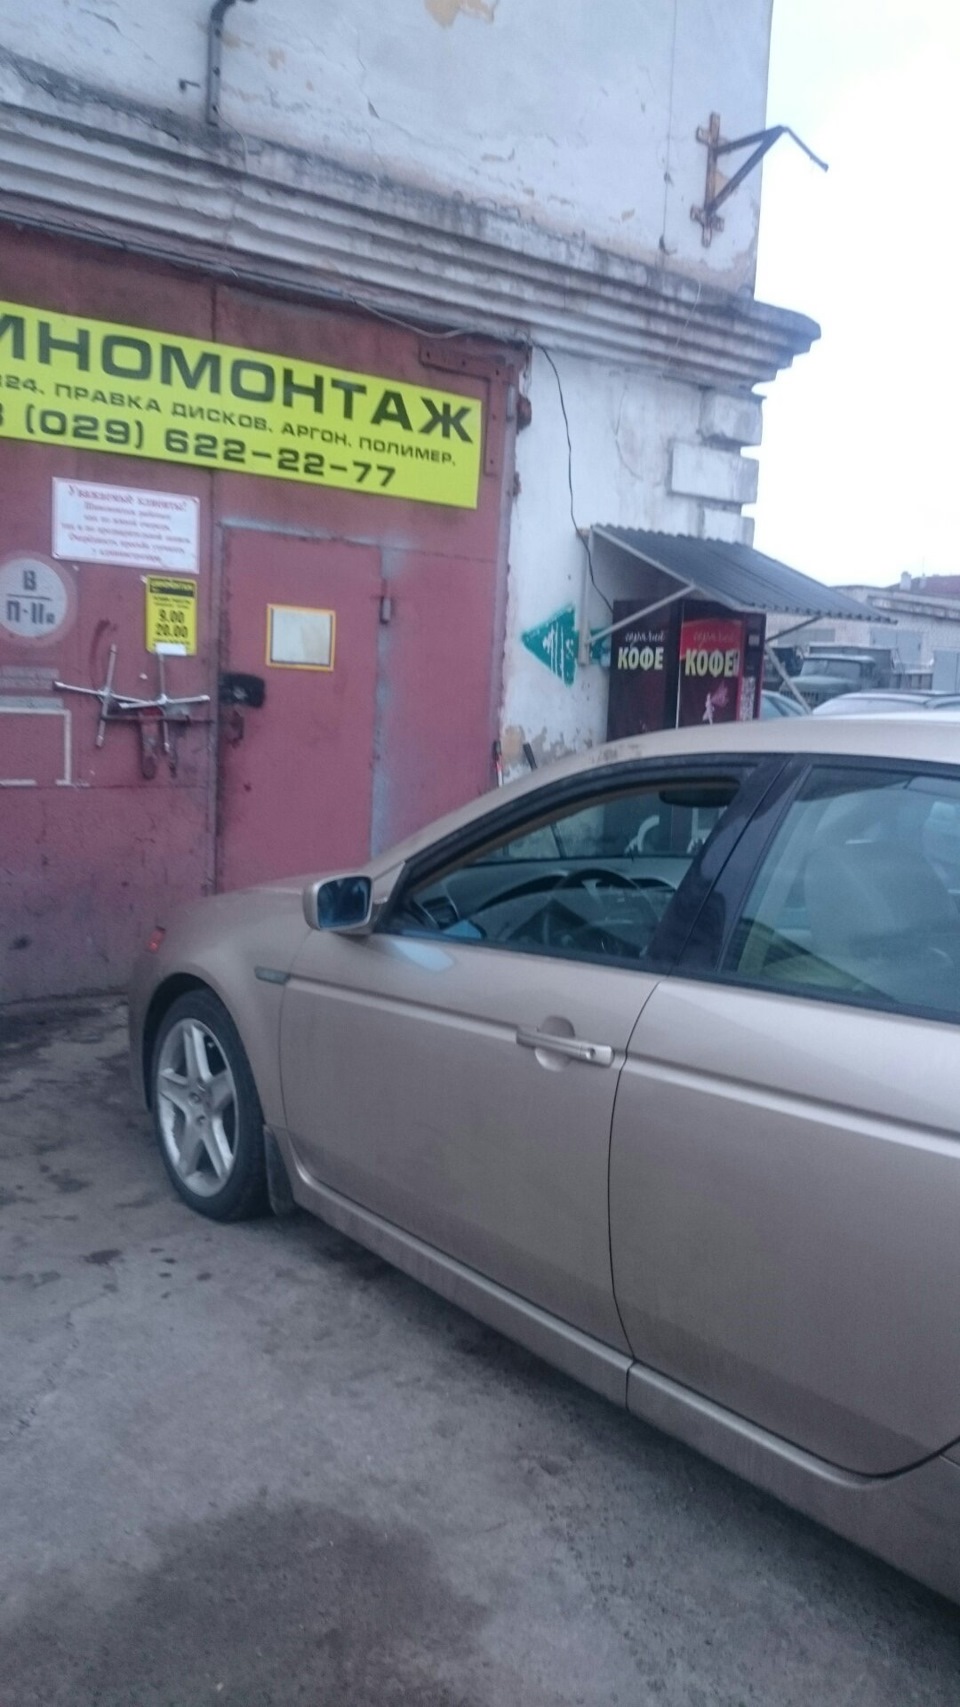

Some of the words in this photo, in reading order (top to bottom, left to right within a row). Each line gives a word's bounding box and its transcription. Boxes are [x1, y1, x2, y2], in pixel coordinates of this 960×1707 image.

[54, 382, 162, 413] ПРАВКА
[25, 403, 144, 449] (029)
[164, 428, 396, 488] 622-22-77
[23, 570, 37, 591] В
[617, 646, 665, 671] КОФЕ
